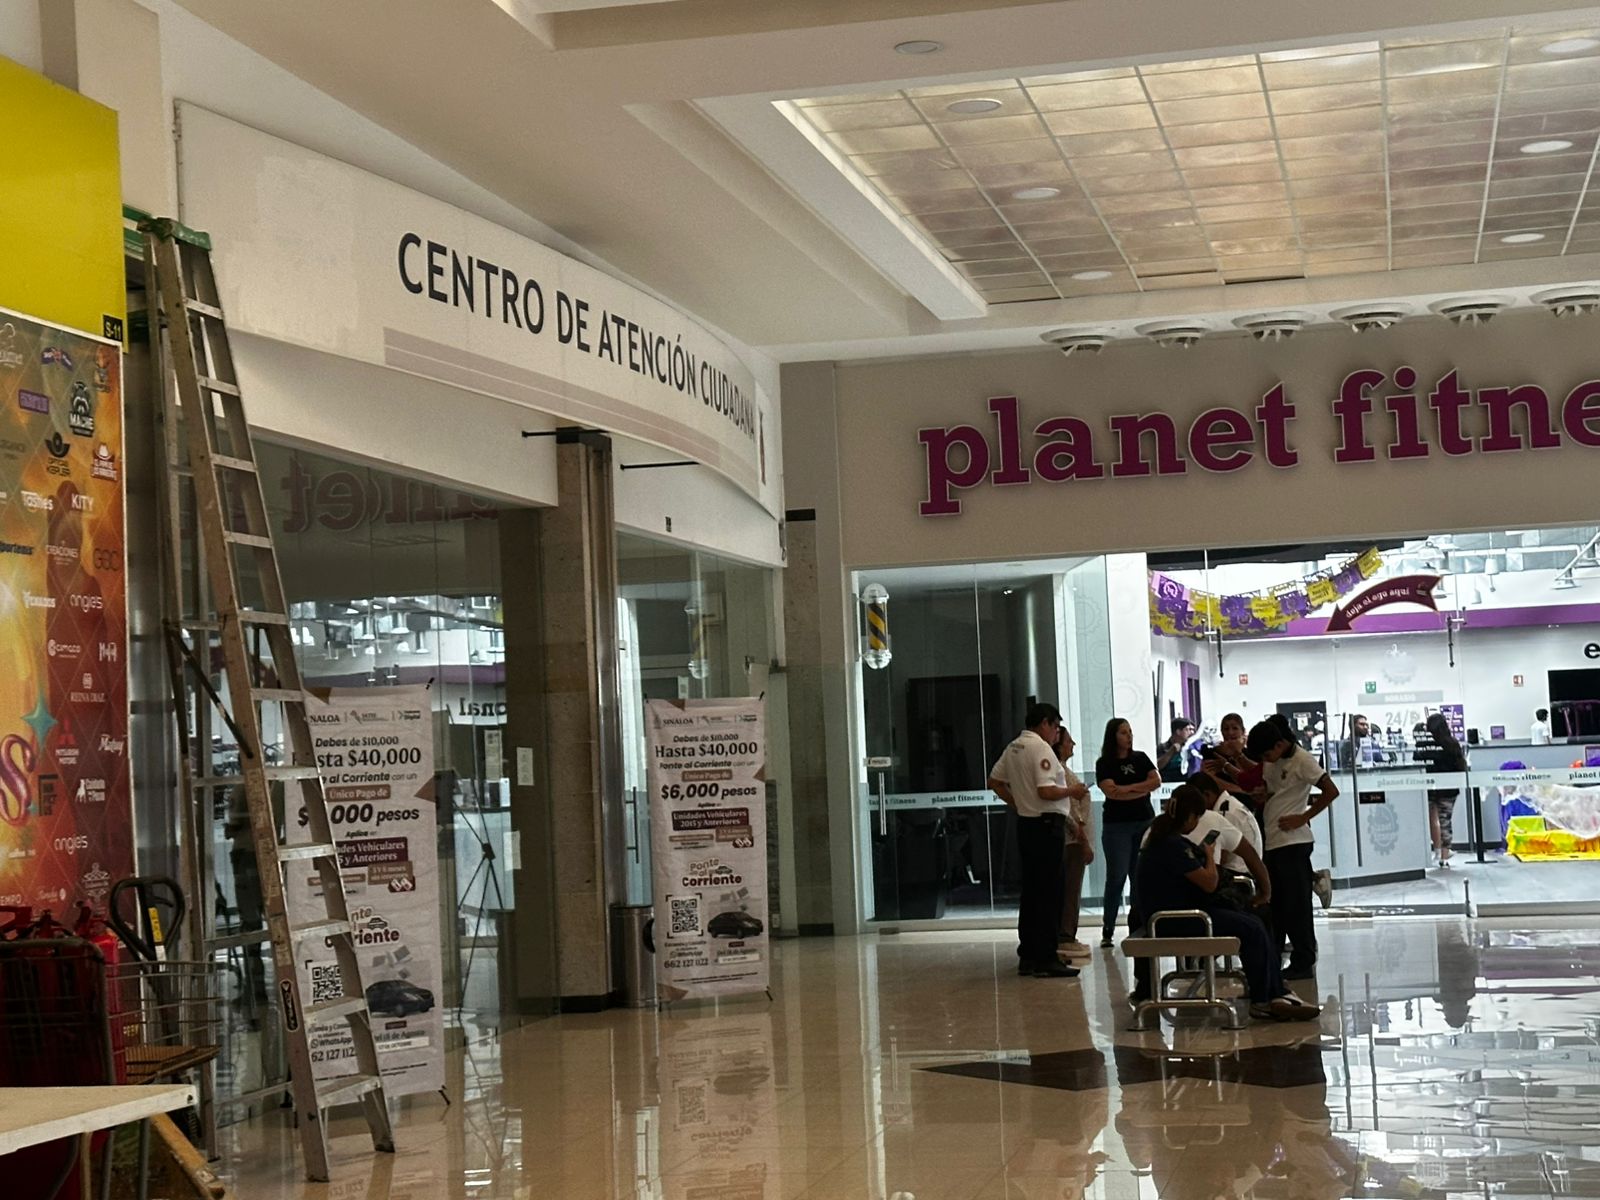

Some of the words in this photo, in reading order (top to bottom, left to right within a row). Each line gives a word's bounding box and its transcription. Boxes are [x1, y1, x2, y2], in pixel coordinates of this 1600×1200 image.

[105, 321, 121, 340] S-11
[398, 232, 544, 335] CENTRO
[556, 290, 590, 353] DE
[598, 310, 698, 399] ATENCIÓN
[700, 360, 756, 442] CIUDADANA
[918, 381, 1298, 516] planet
[1332, 365, 1600, 463] fitne
[1345, 603, 1363, 618] deja
[1362, 595, 1372, 605] el
[310, 715, 340, 723] NALOA
[662, 718, 694, 726] SINALOA
[315, 738, 347, 747] Debes
[350, 737, 360, 746] de
[362, 736, 399, 746] $10,000
[673, 735, 699, 743] Debes
[700, 734, 709, 742] de
[655, 745, 695, 758] Hasta
[698, 742, 758, 757] $40,000
[348, 747, 421, 768] $40,000
[693, 760, 732, 768] Corriente
[329, 774, 340, 784] al
[342, 772, 390, 783] Corriente
[1569, 771, 1596, 780] planet
[661, 783, 719, 801] $6,000
[721, 787, 757, 800] pesos
[932, 796, 957, 804] planet
[958, 794, 985, 802] fitness
[376, 809, 420, 826] pesos
[706, 810, 747, 819] Vehiculares
[703, 817, 741, 826] Anteriores
[357, 841, 405, 853] Vehiculares
[352, 851, 398, 863] Anteriores
[690, 858, 720, 871] Ponte
[682, 875, 742, 887] Corriente
[319, 1037, 352, 1046] WhatsApp
[326, 1049, 340, 1060] 127
